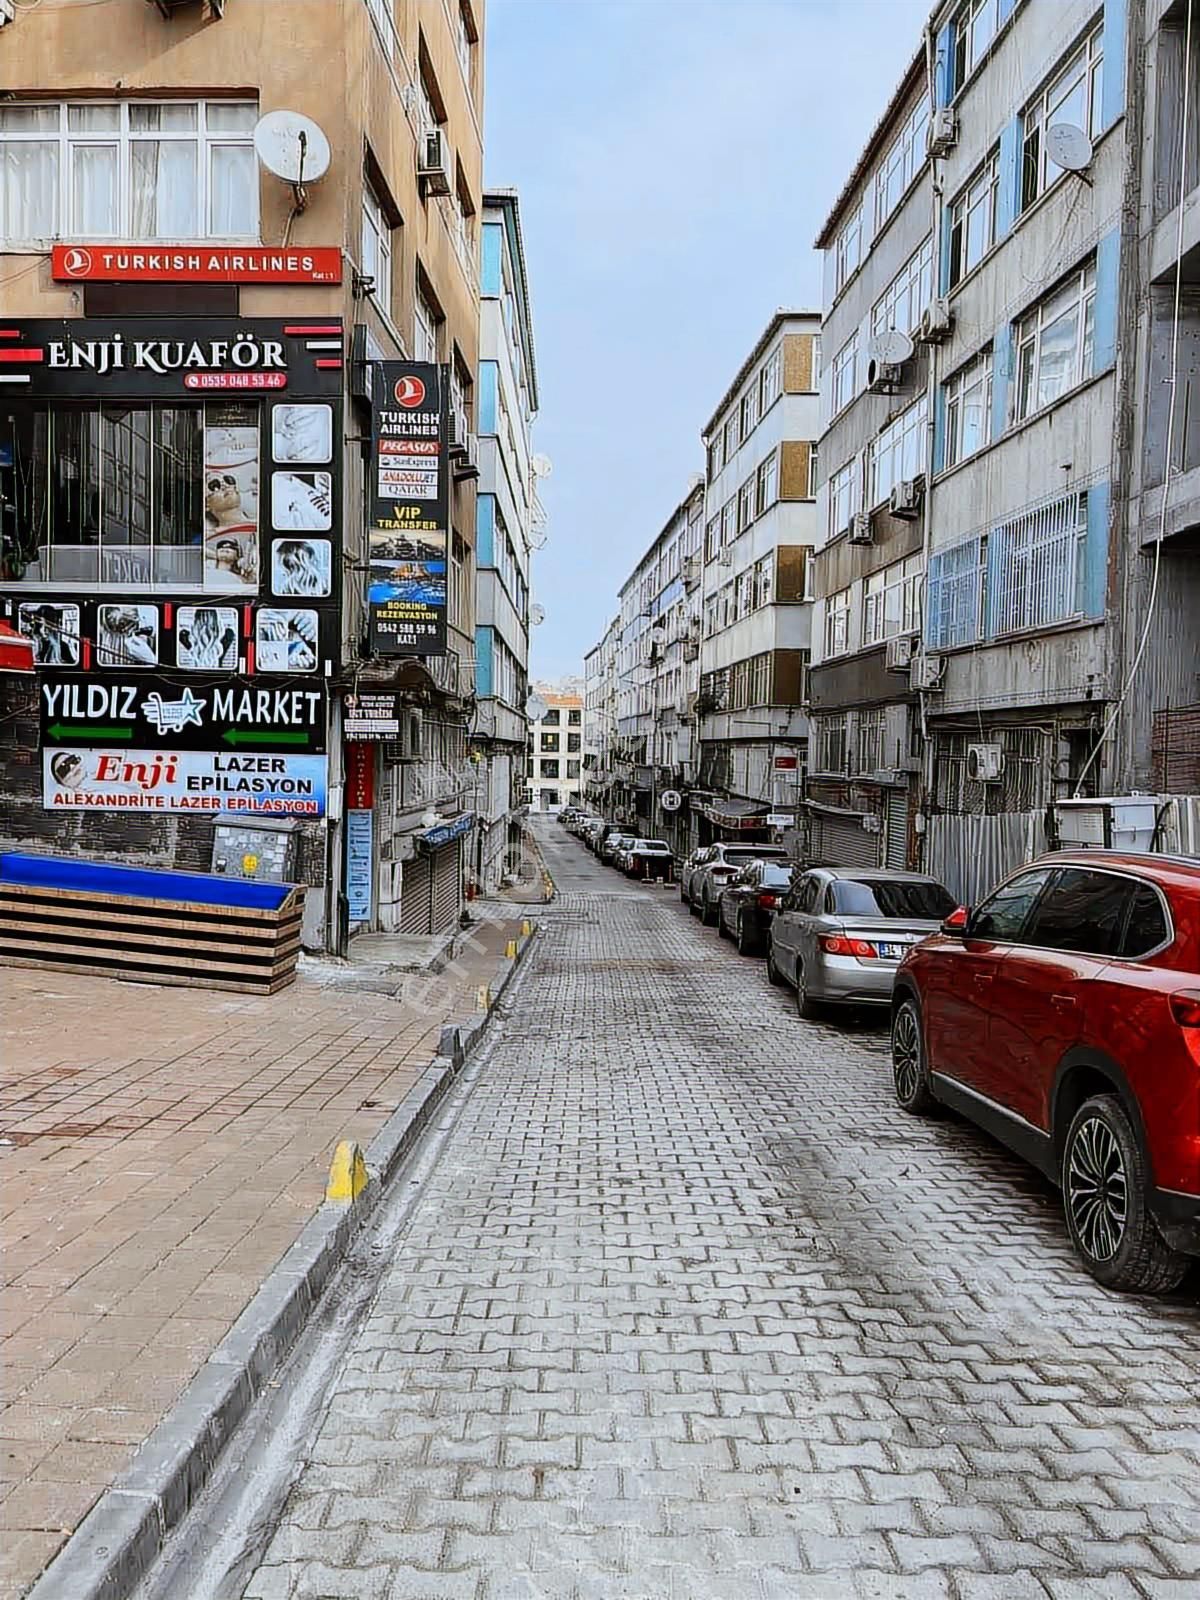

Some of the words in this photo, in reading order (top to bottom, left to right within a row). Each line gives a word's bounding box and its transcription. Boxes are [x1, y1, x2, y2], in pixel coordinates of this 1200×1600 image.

[102, 254, 200, 270] TURKISH
[208, 256, 314, 271] AIRLINES
[134, 334, 287, 373] KUAFÖR
[202, 376, 226, 386] 0535
[379, 412, 440, 424] TURKISH
[383, 440, 435, 452] PEGASUS
[378, 519, 437, 530] TRANSFER
[387, 602, 427, 610] BOOKING
[376, 610, 438, 620] REZERVASYON
[378, 622, 397, 632] 0542
[42, 684, 137, 719] YILDIZ
[212, 688, 320, 724] MARKET
[214, 756, 286, 772] LAZER
[93, 755, 178, 790] Enji
[187, 773, 312, 794] EPİLASYON
[54, 793, 164, 808] ALEXANDRİTE
[170, 796, 220, 808] LAZER
[228, 796, 317, 812] EPİLASYON
